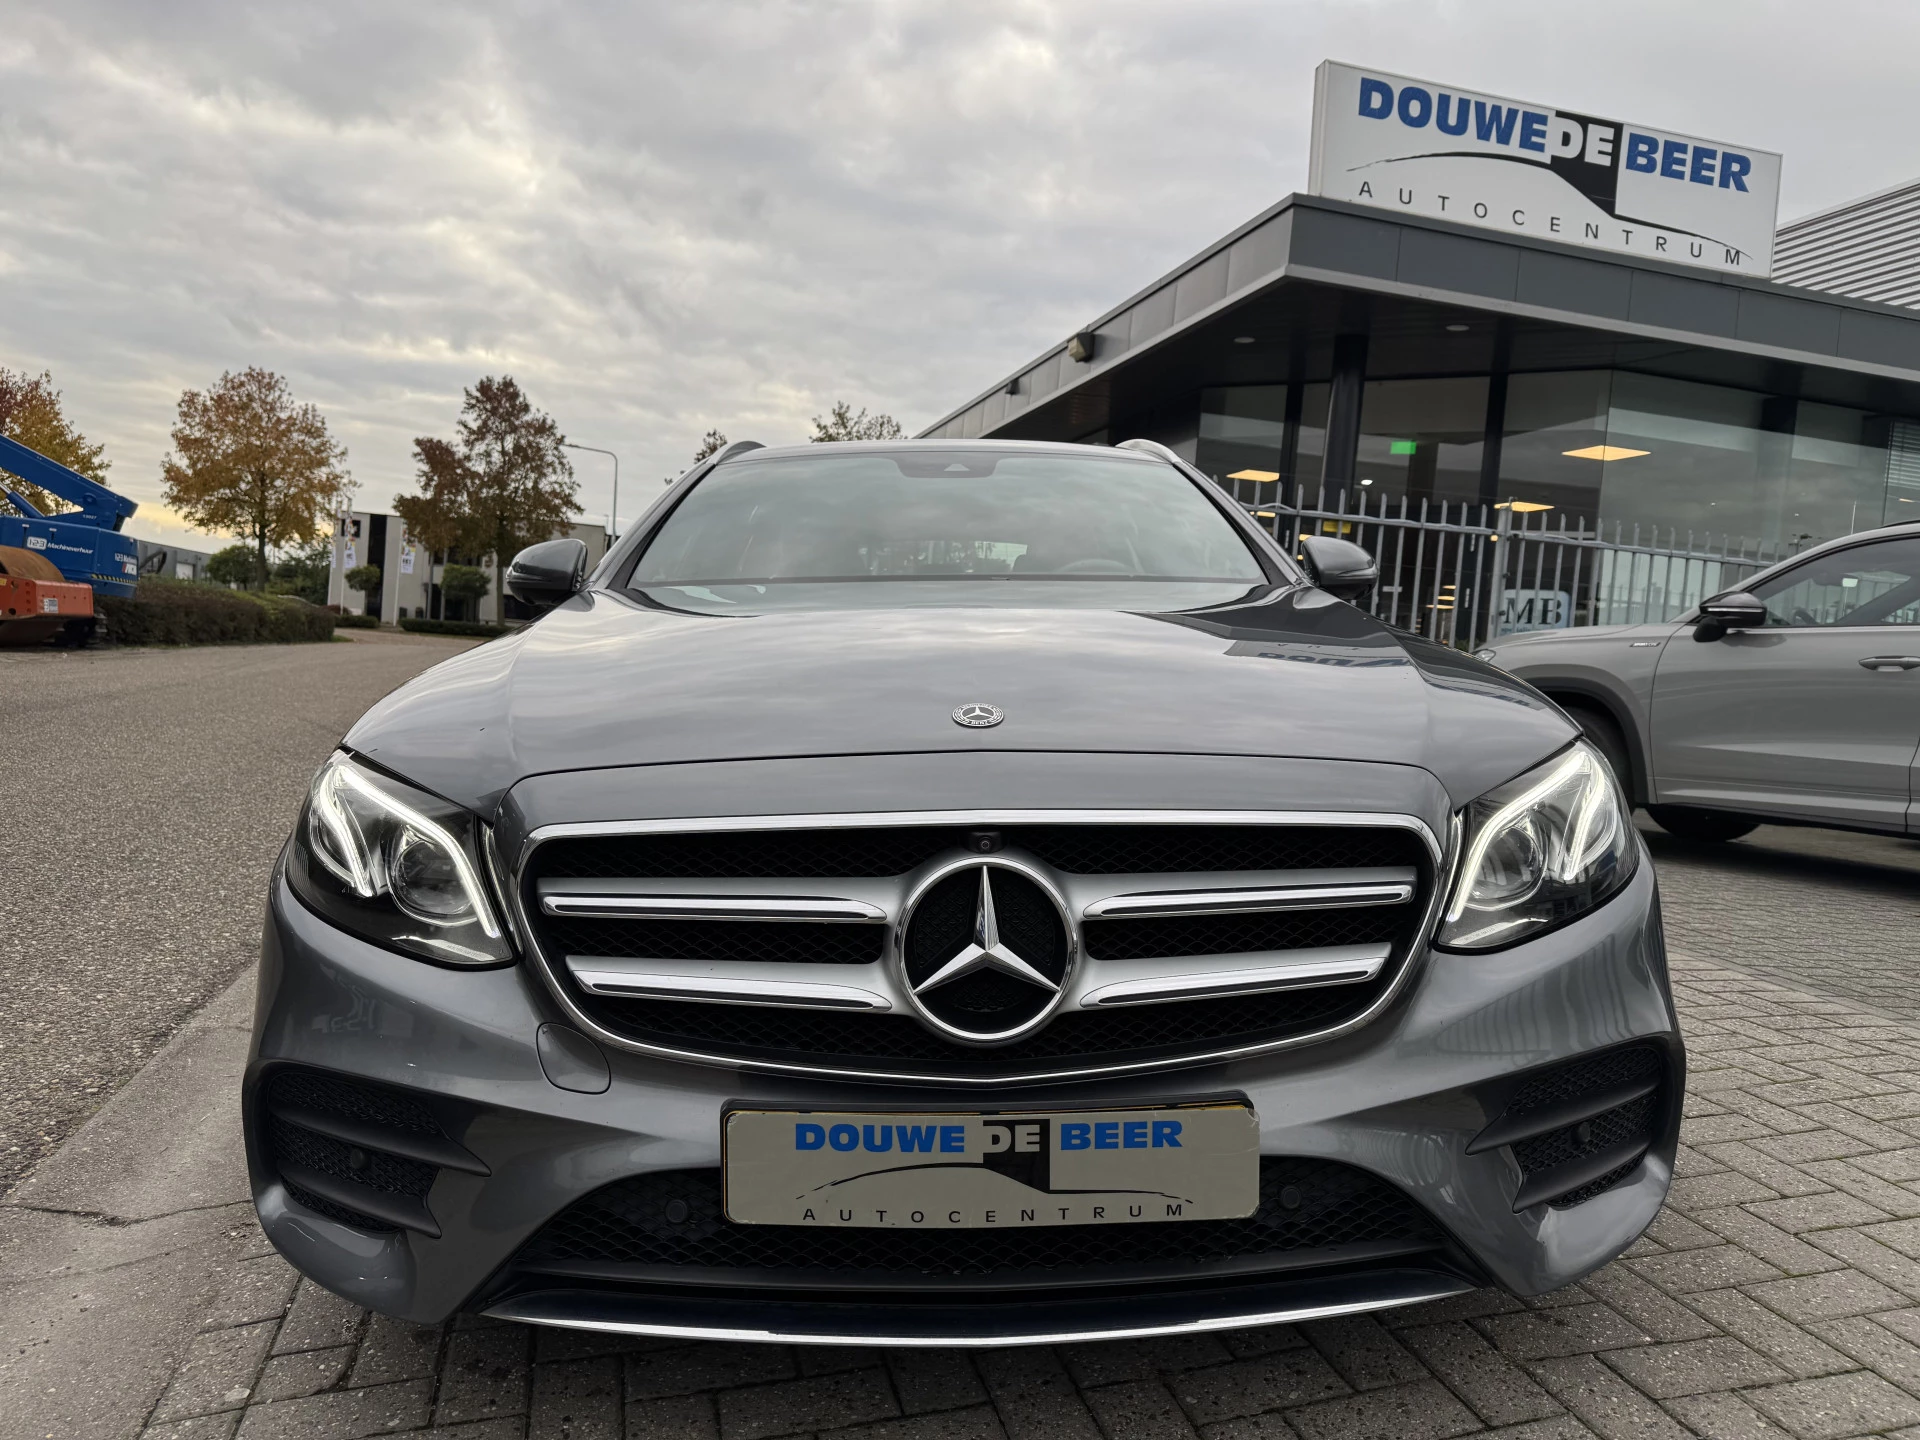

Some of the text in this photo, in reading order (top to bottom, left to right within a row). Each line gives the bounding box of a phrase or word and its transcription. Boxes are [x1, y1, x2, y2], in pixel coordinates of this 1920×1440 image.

[1358, 77, 1751, 192] DOUWE DE BEER
[1358, 181, 1743, 266] AUTOCENTRUM
[47, 542, 93, 554] Machineverhuur
[1504, 597, 1562, 625] MB
[796, 1121, 1182, 1153] DOUWE DE BEER
[803, 1204, 1183, 1223] AUTOCENTRUM
